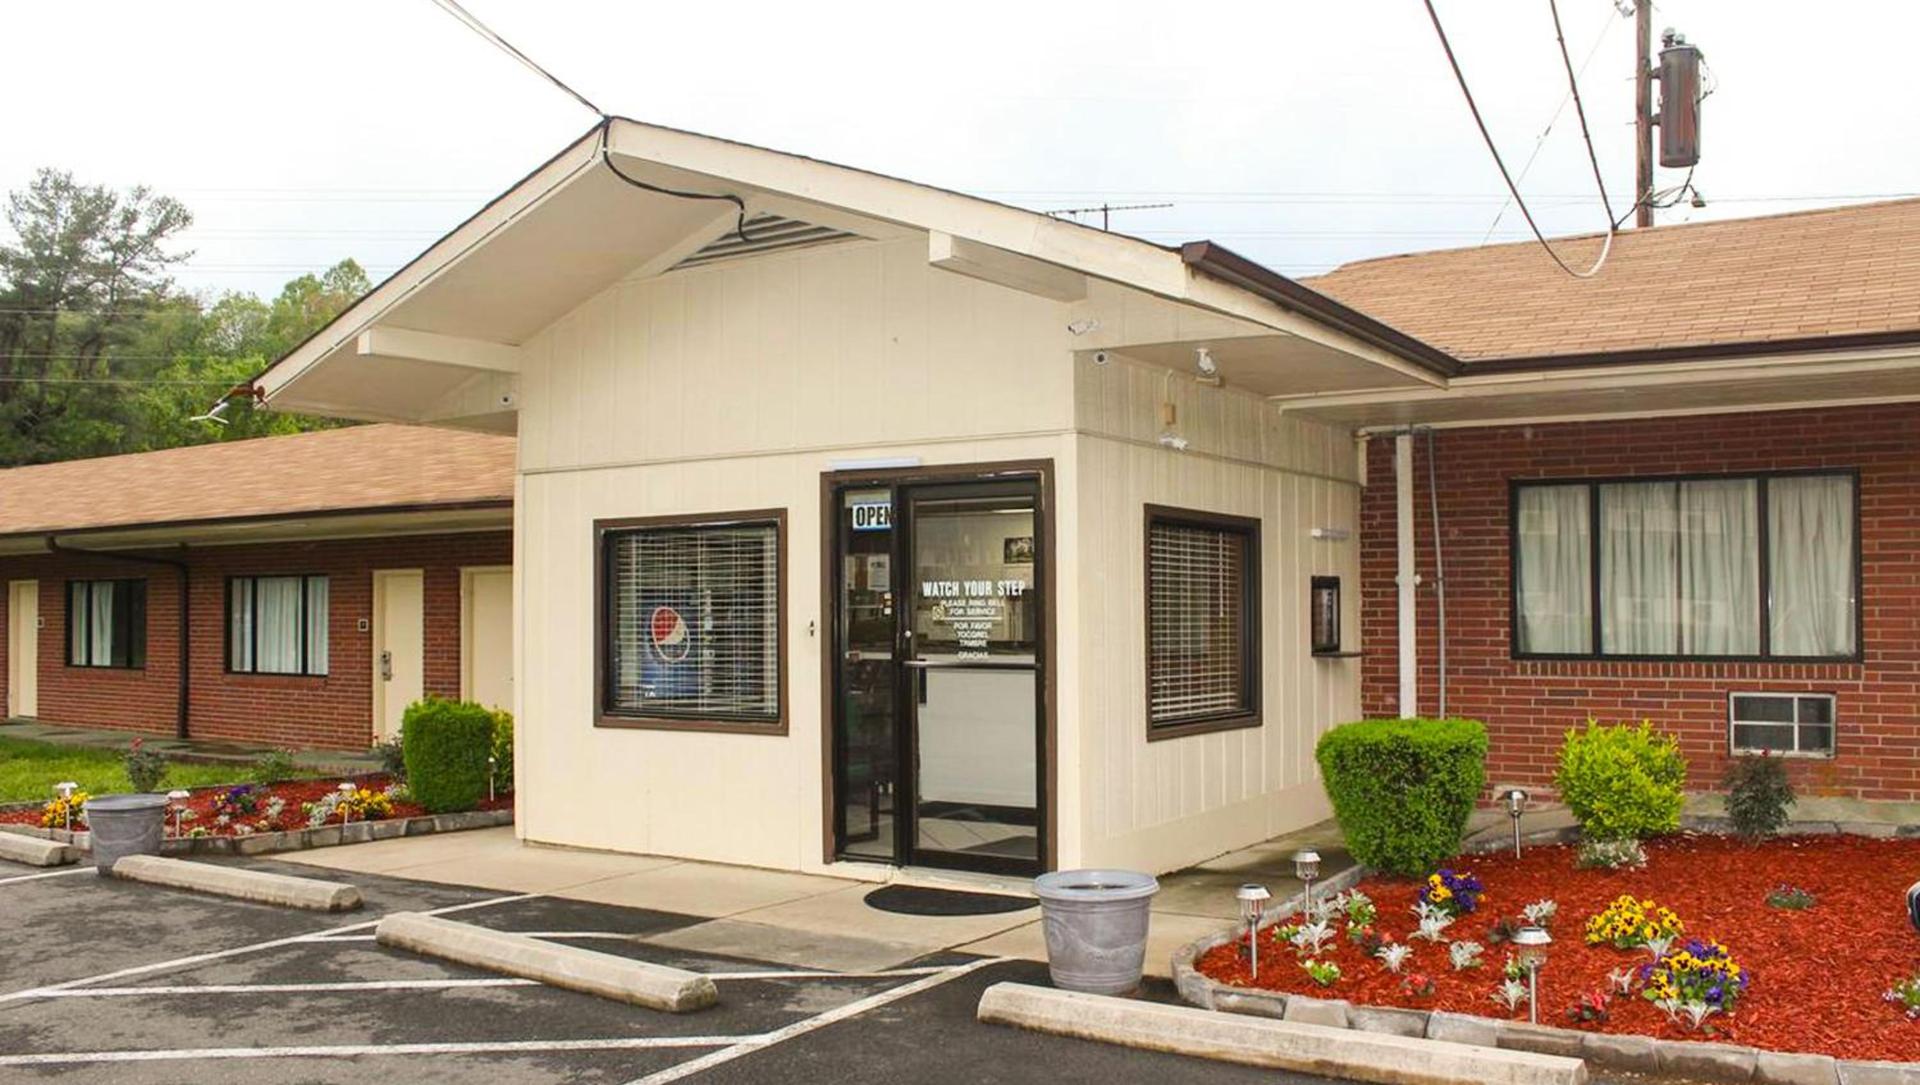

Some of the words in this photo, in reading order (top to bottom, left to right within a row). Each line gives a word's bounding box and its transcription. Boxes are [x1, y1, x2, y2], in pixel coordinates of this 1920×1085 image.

[855, 506, 893, 527] OPEN
[922, 581, 959, 597] WATCH
[963, 580, 992, 597] YOUR
[997, 580, 1026, 596] STEP
[949, 607, 964, 616] FOR
